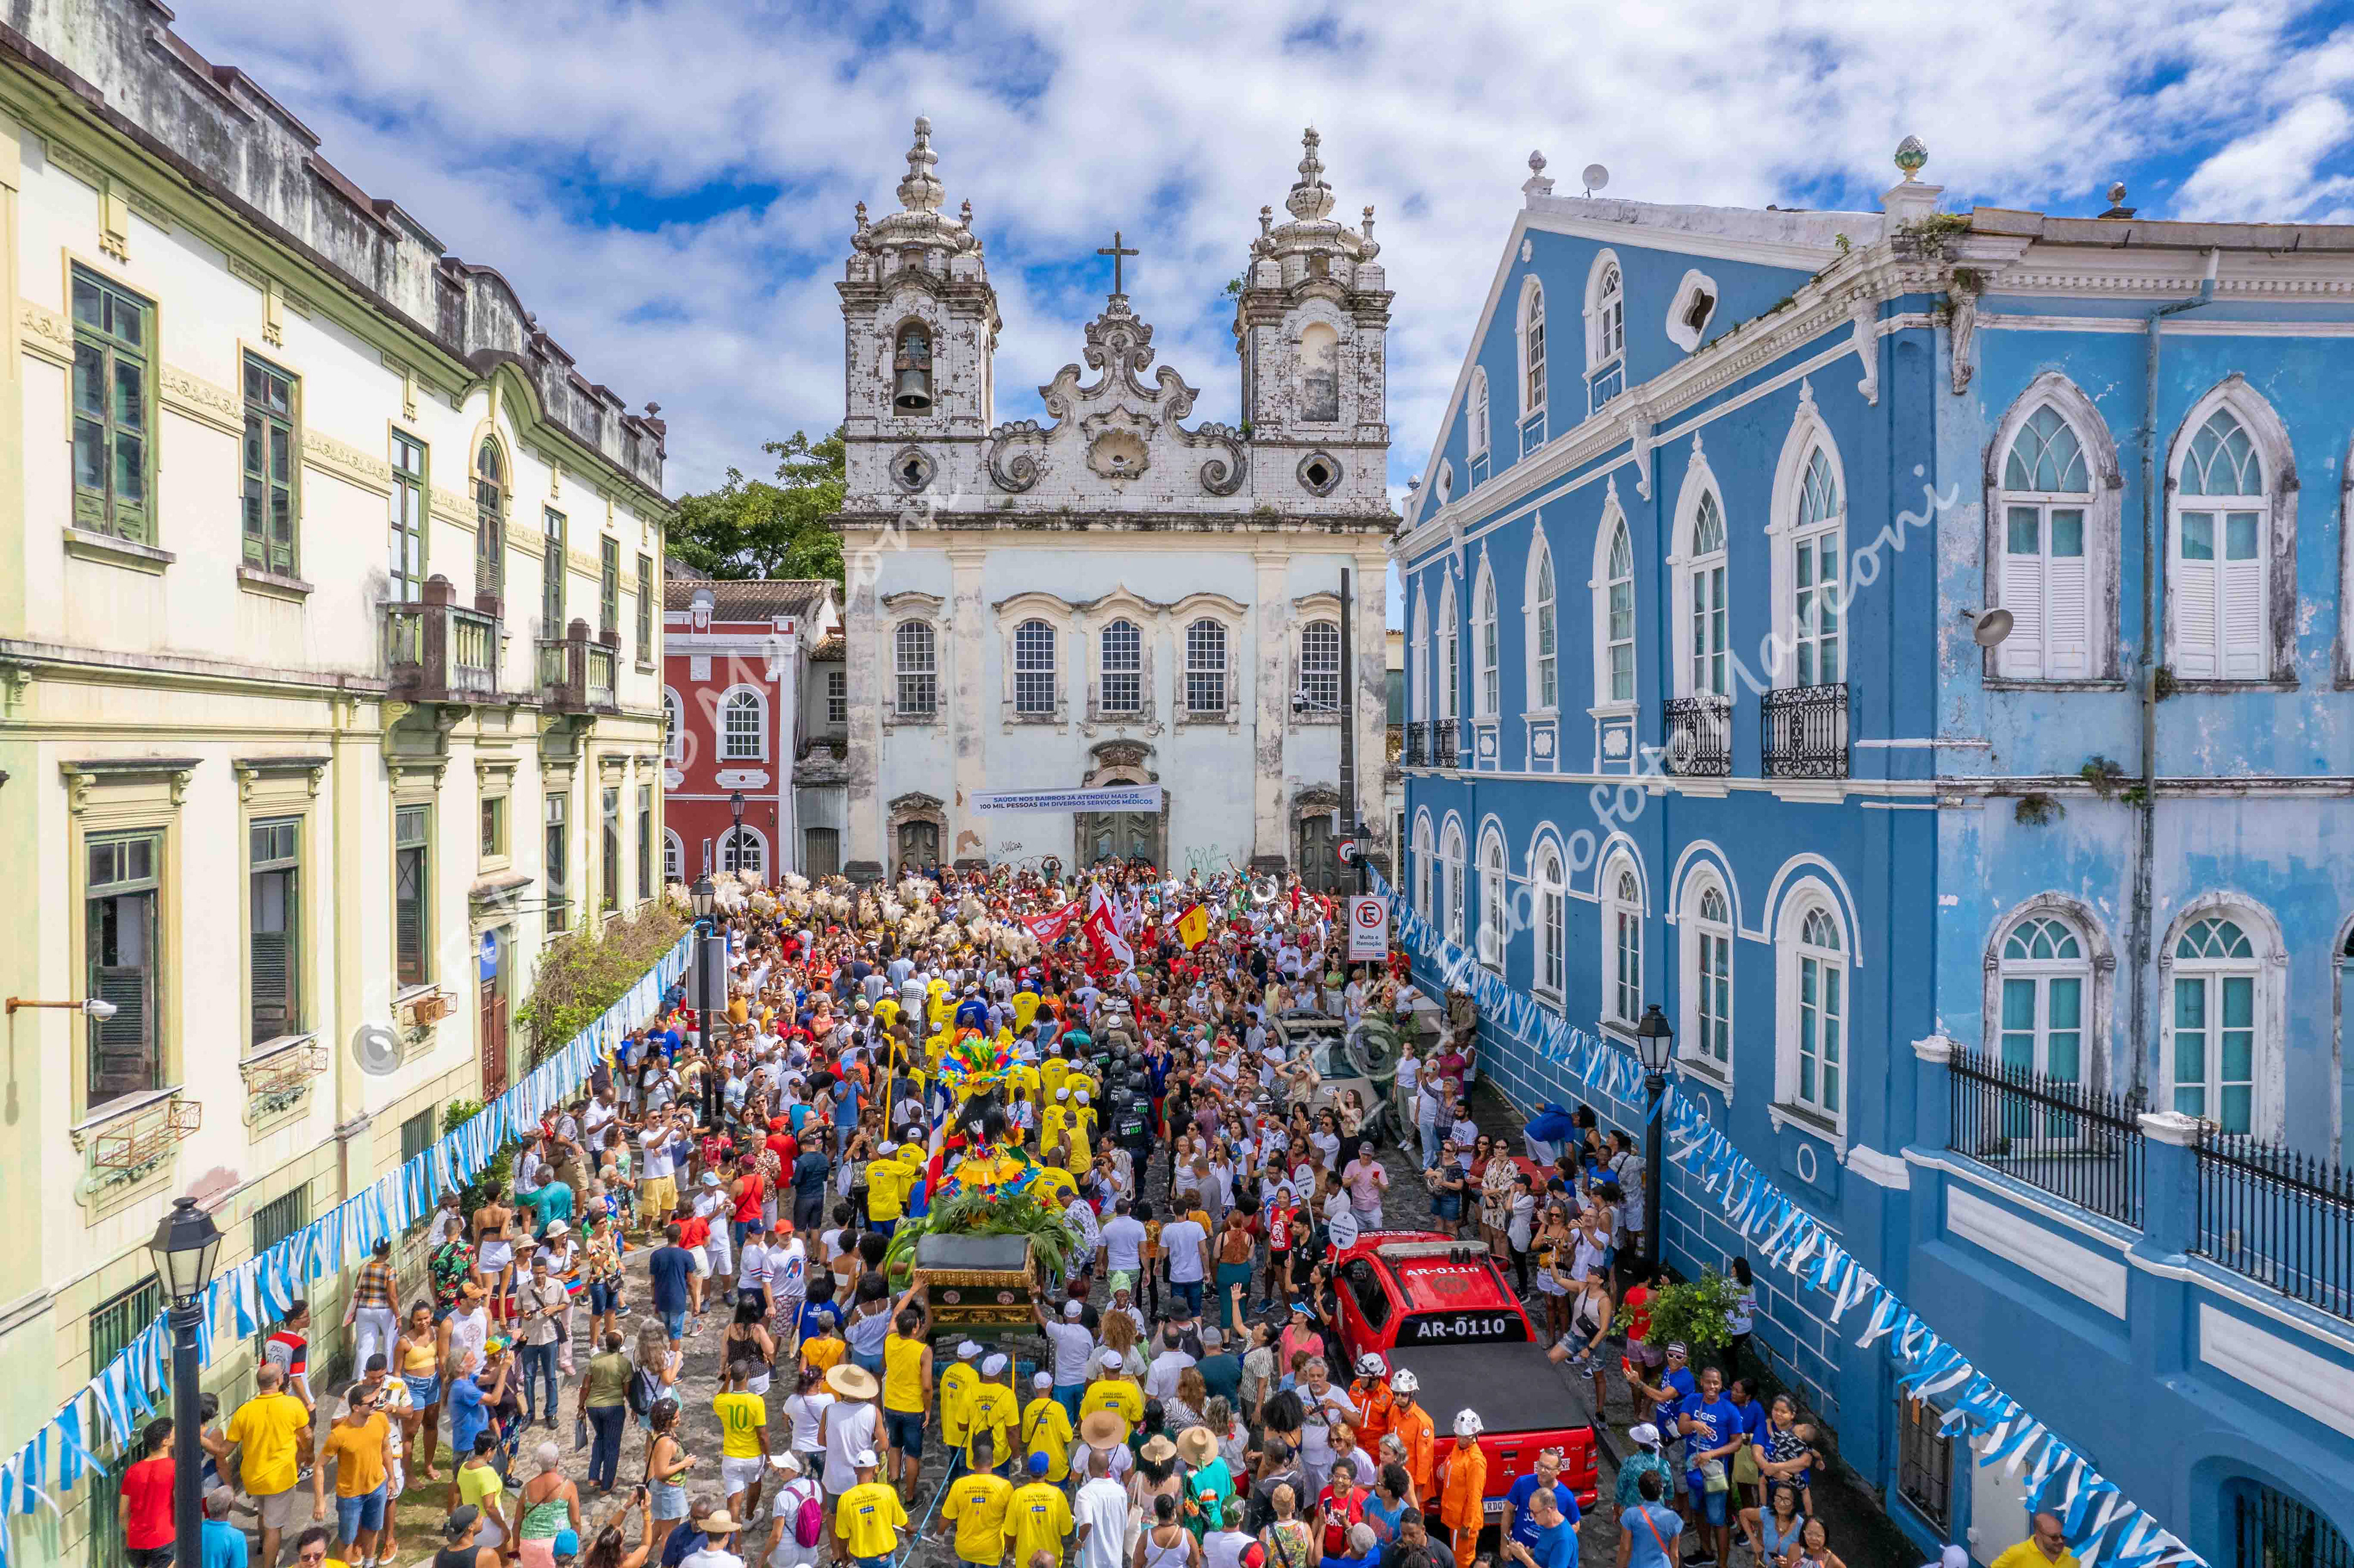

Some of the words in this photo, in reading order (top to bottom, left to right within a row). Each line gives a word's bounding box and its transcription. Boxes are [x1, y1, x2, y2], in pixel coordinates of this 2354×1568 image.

[1406, 1266, 1479, 1276] AR-0110
[1417, 1319, 1506, 1338] AR-0110
[728, 1404, 748, 1429] 10
